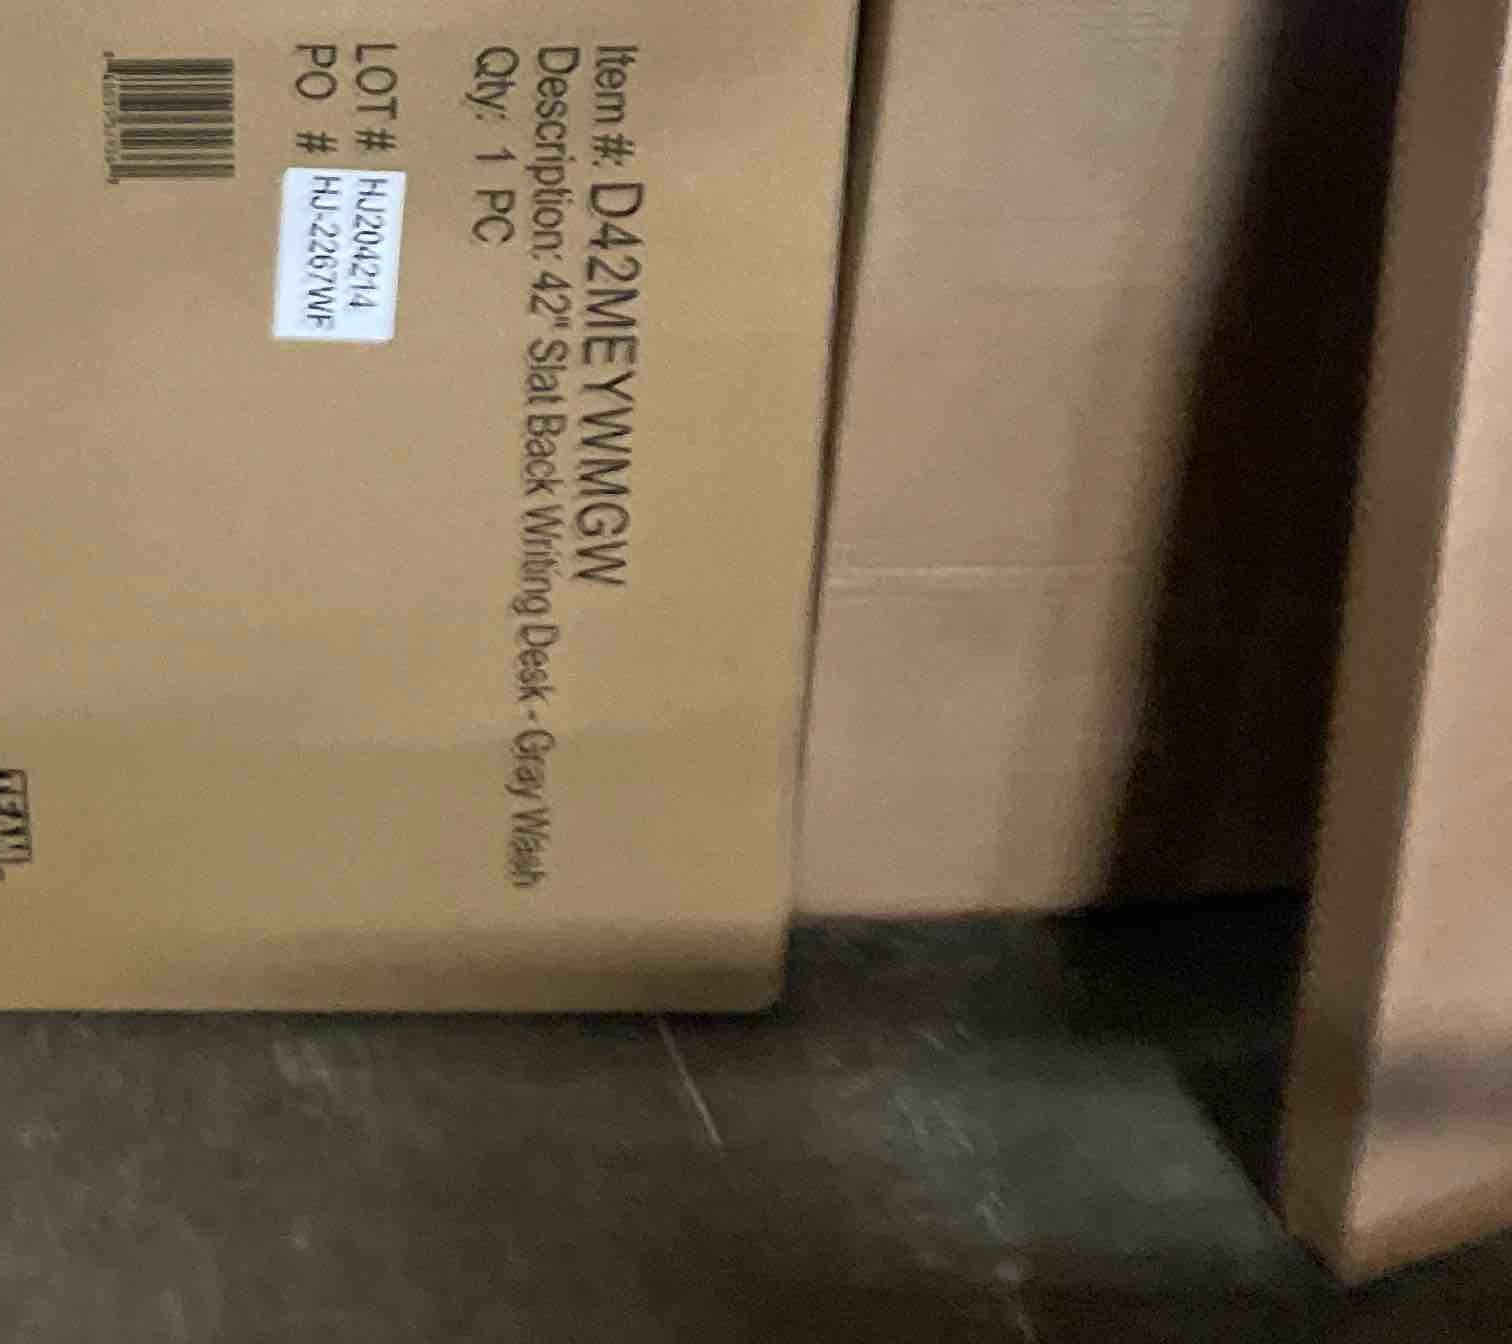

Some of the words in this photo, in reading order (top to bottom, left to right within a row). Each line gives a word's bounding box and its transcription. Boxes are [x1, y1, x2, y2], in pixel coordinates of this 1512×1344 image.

[294, 43, 338, 101] PO
[354, 43, 399, 120] LOT
[465, 45, 520, 121] Qty:
[592, 44, 640, 124] Item
[295, 131, 338, 154] #
[353, 127, 397, 152] #
[474, 146, 518, 164] 1
[524, 46, 581, 261] Description:
[591, 133, 635, 167] #:
[306, 174, 341, 331] HJ-2267WF
[346, 176, 389, 310] HJ204214
[470, 188, 517, 244] PC
[528, 270, 574, 329] 42"
[524, 336, 569, 405] Slat
[574, 181, 645, 586] D42MEYWMGW
[522, 413, 567, 497] Back
[510, 503, 566, 615] Writing
[516, 624, 560, 704] Desk
[505, 727, 556, 800] Gray
[510, 807, 551, 889] Wash
